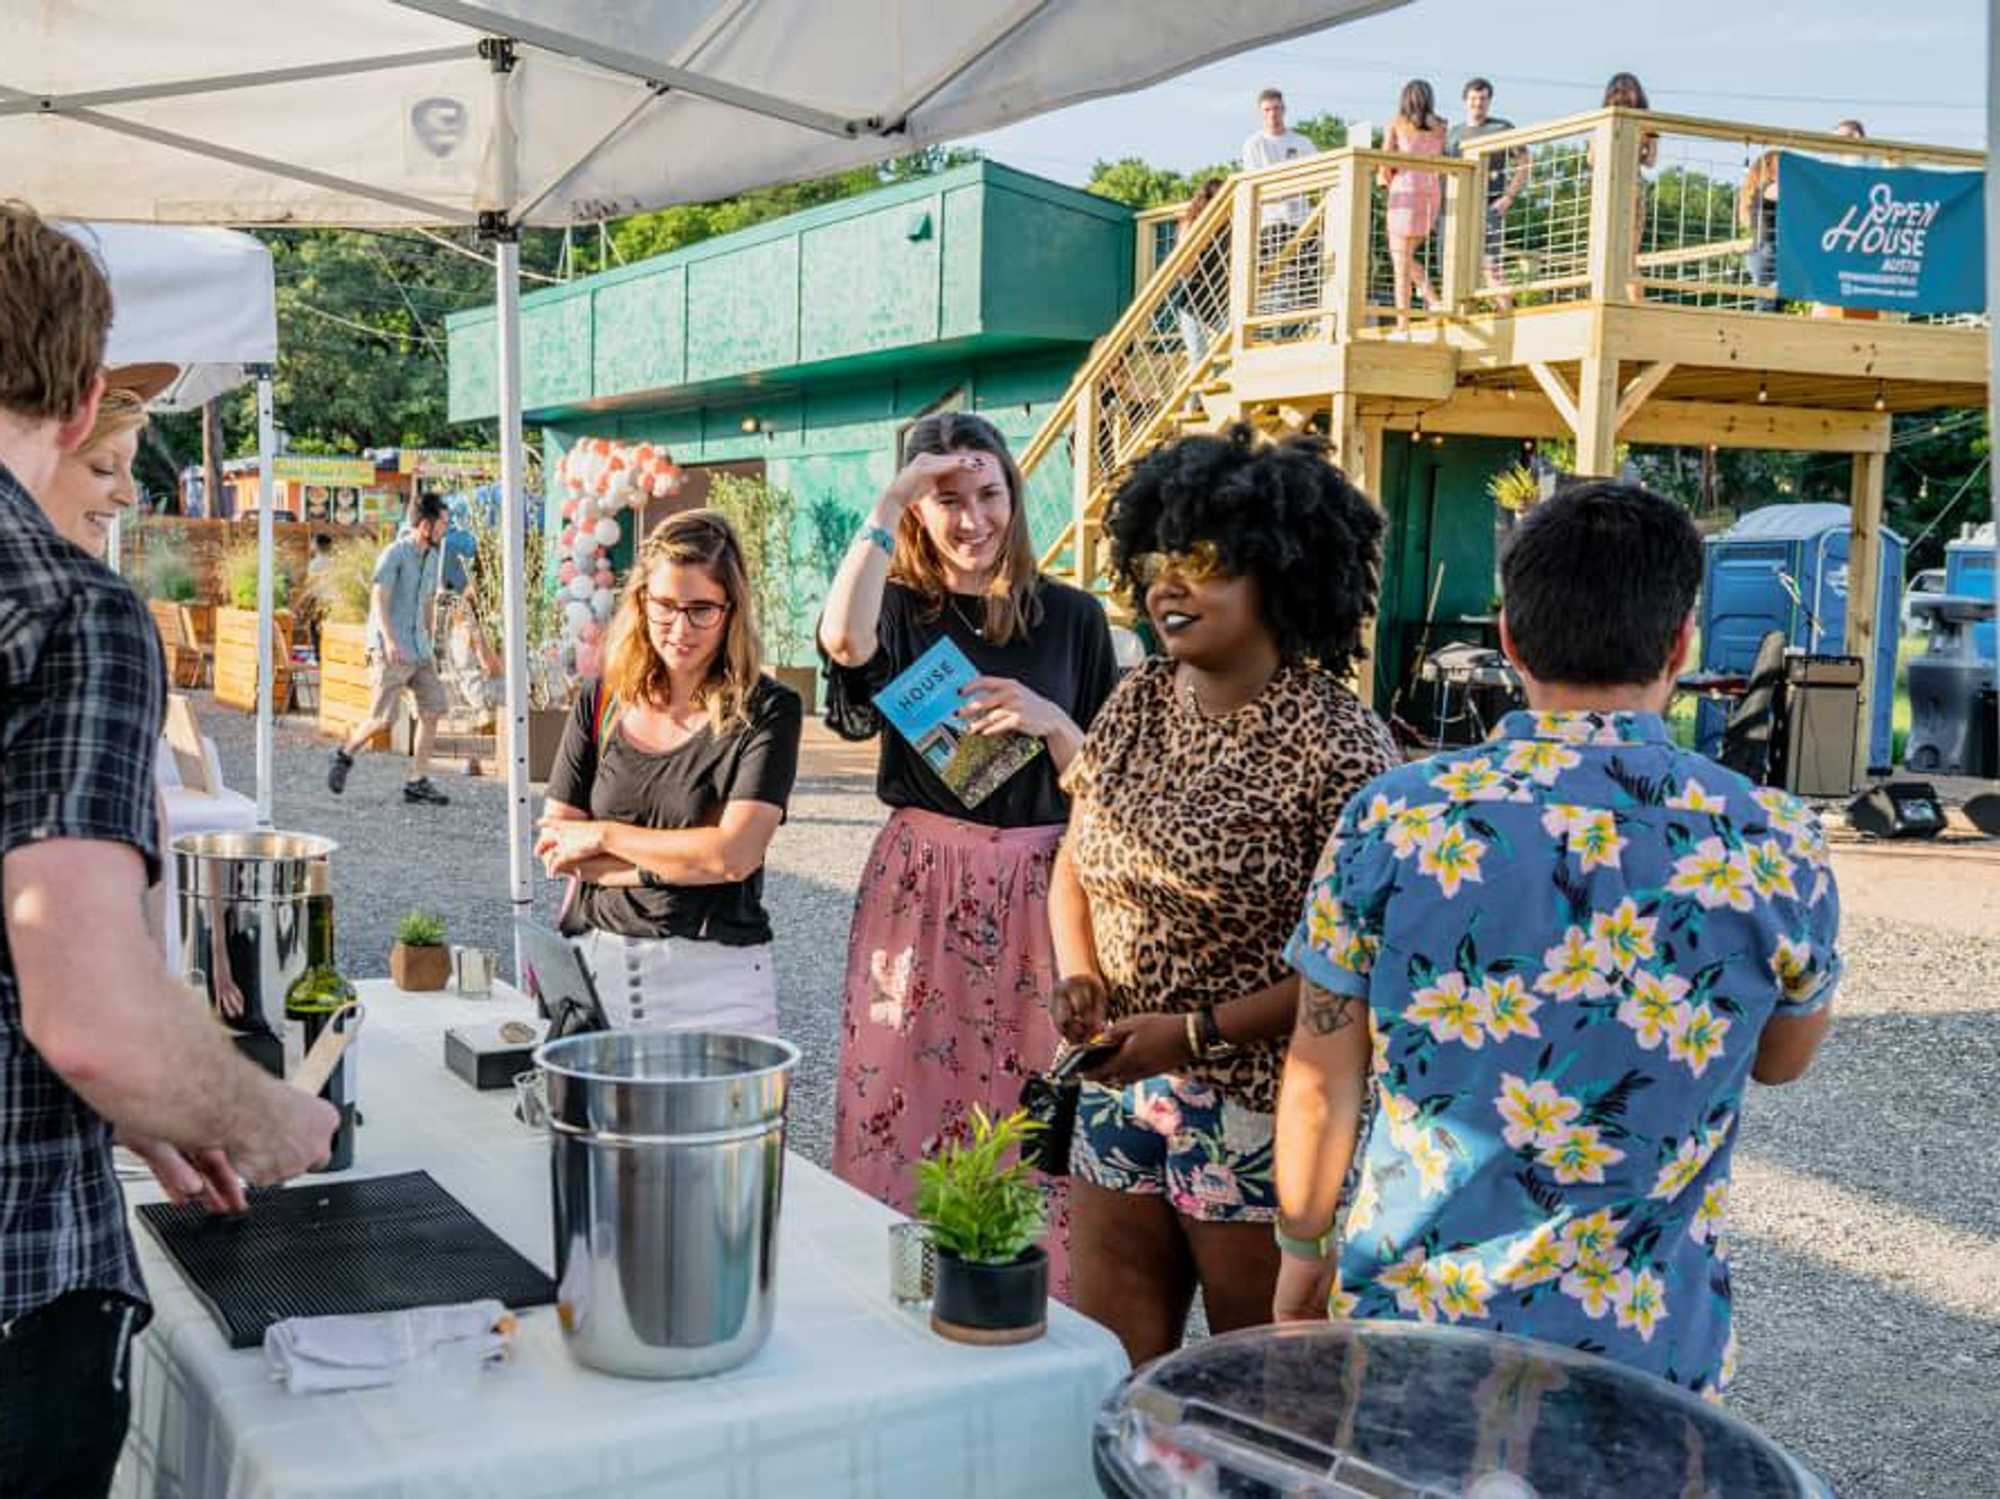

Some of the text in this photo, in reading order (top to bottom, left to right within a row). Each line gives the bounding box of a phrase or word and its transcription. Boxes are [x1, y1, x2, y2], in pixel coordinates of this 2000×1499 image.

[1870, 184, 1939, 227] OPEN
[1822, 205, 1926, 256] HOUSE
[899, 661, 954, 710] HOUSE
